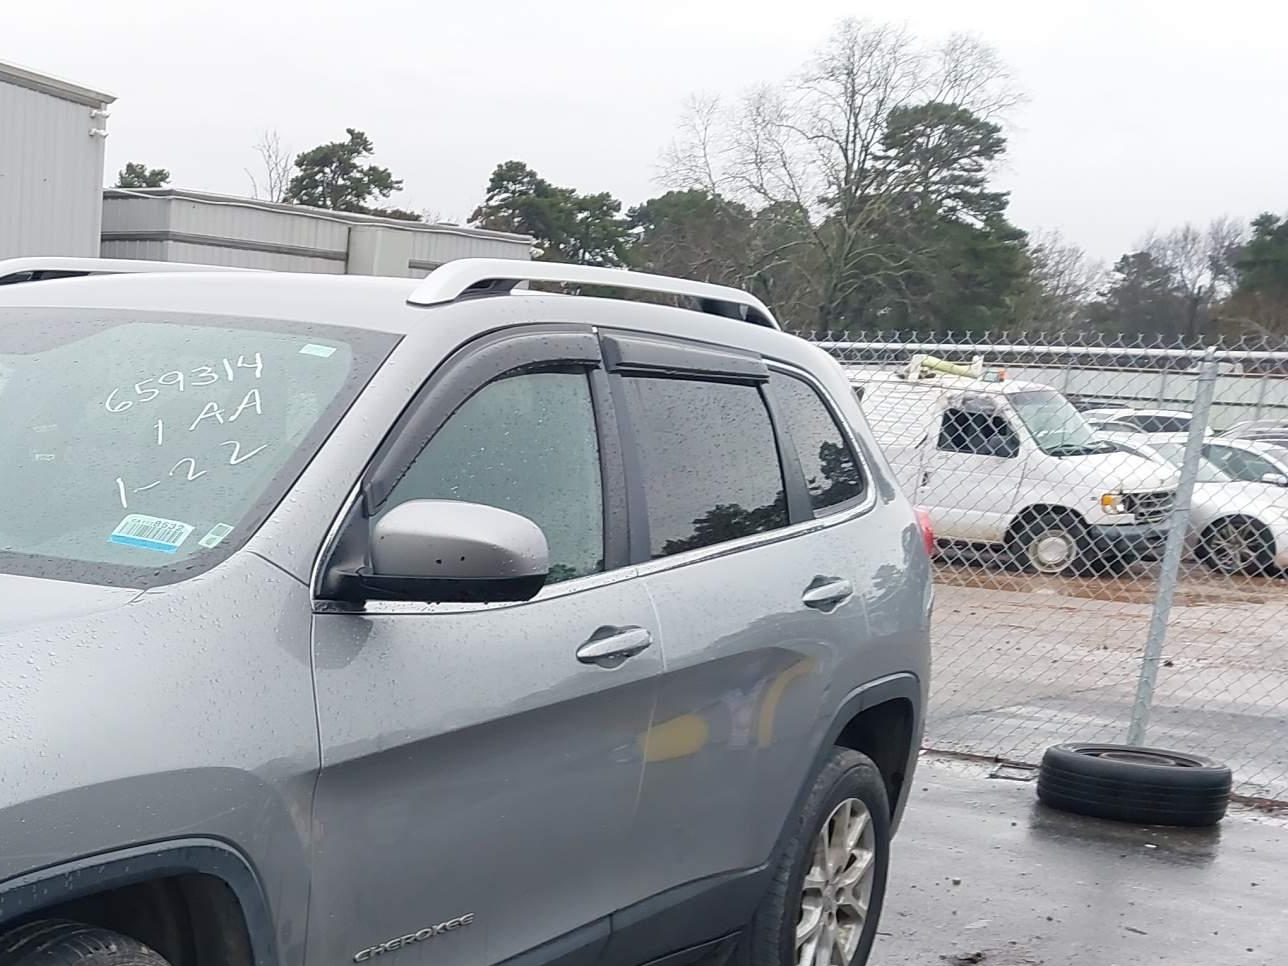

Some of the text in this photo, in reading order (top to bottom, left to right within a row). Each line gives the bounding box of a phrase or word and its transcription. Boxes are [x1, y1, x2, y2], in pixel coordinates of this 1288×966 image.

[105, 352, 263, 413] 659314
[153, 418, 163, 445] 1
[354, 912, 474, 962] CHEROKEE
